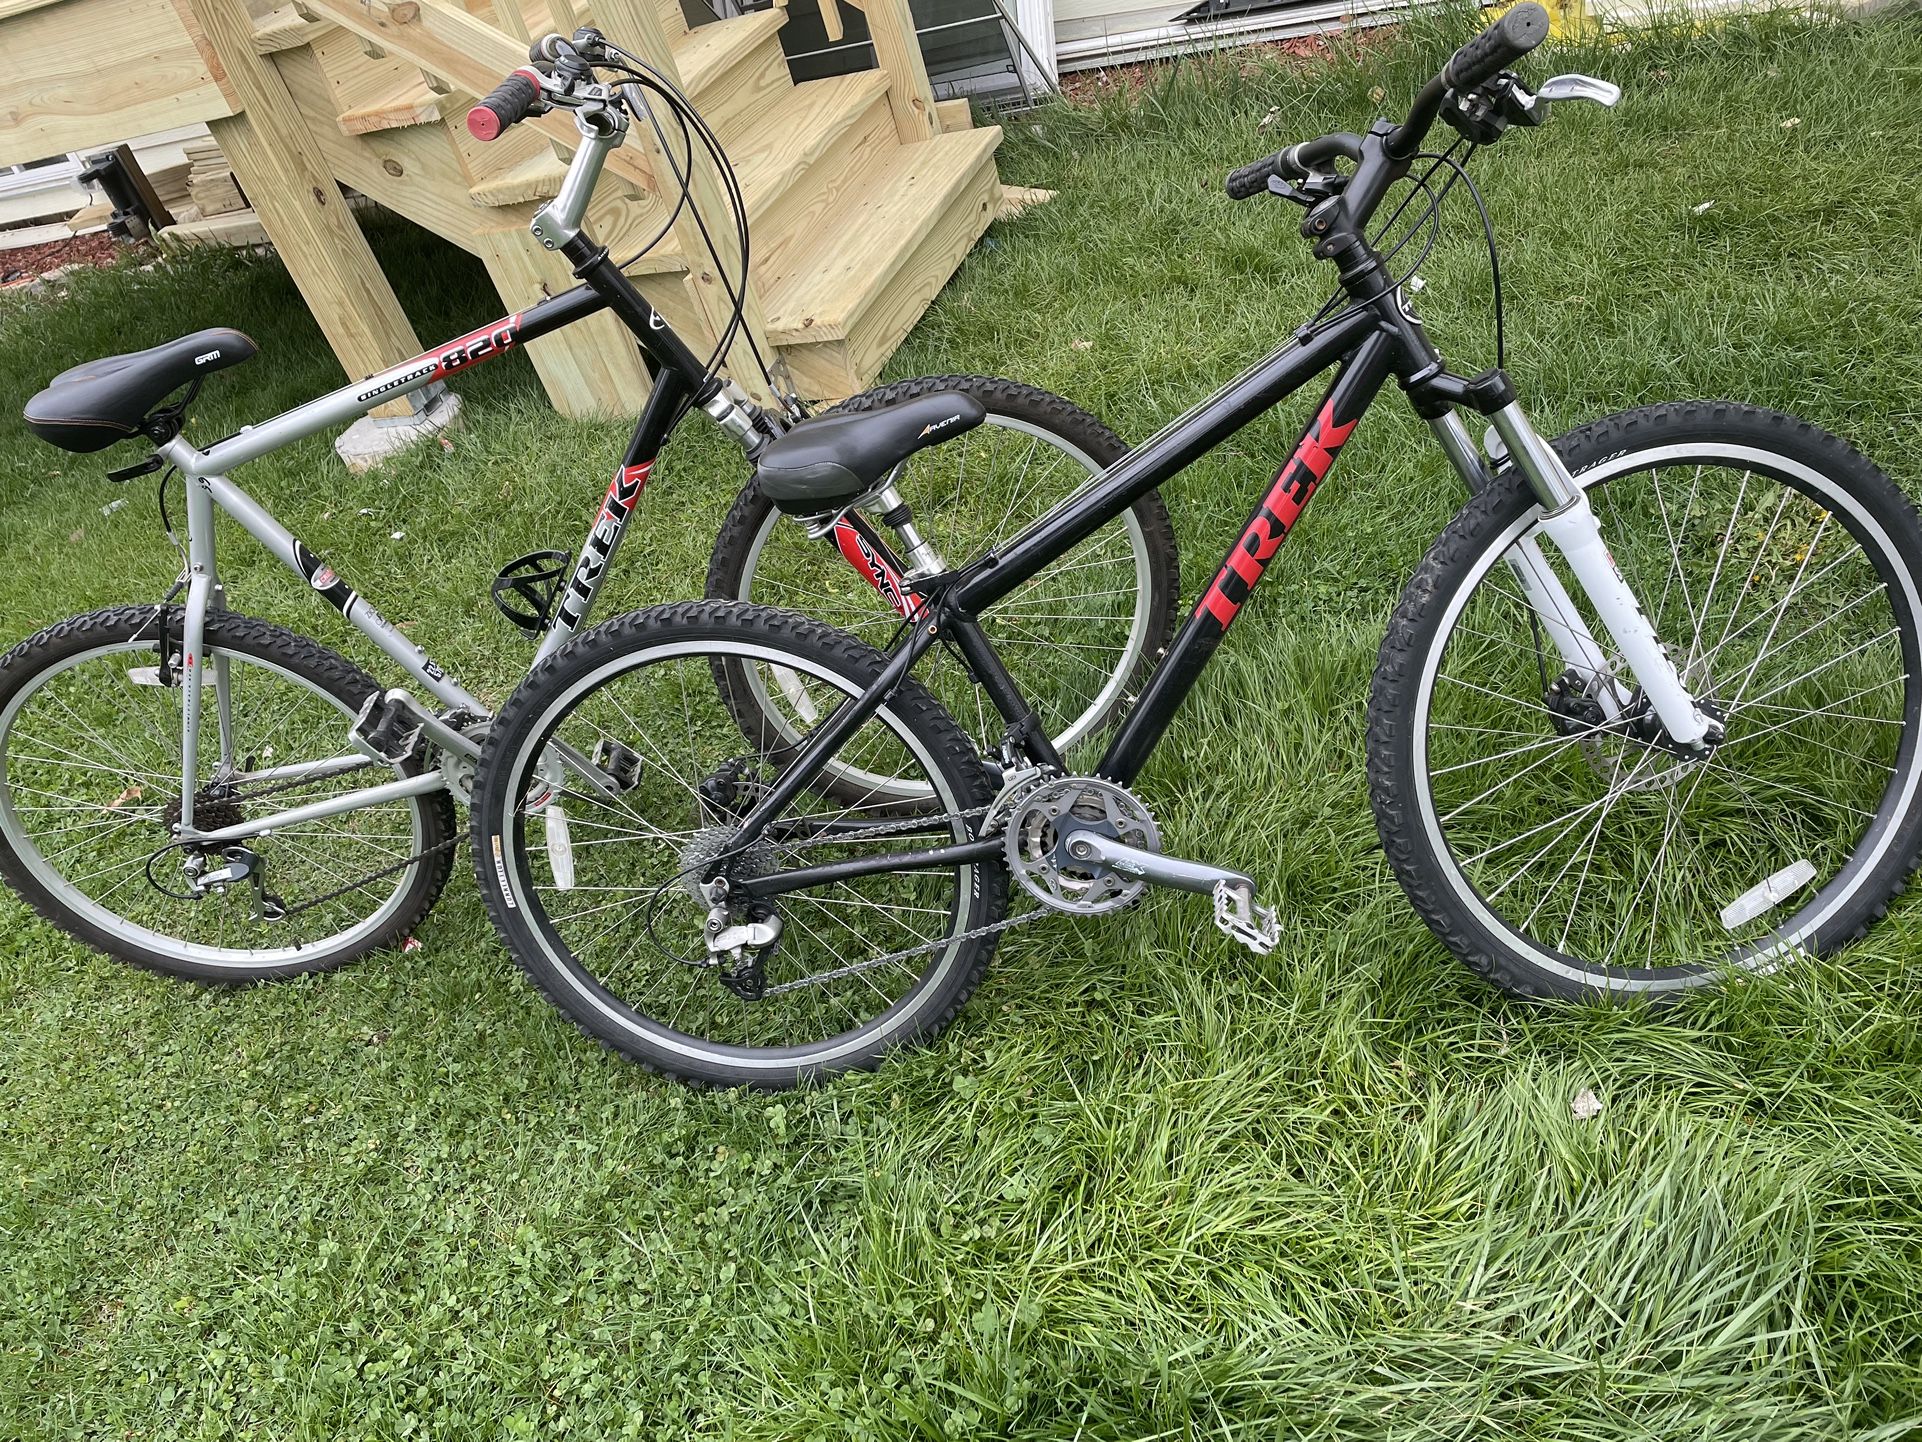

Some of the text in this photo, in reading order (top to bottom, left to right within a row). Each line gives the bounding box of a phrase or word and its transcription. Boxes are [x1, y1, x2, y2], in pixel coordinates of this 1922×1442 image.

[194, 349, 221, 366] GRM
[359, 323, 514, 401] SINGLETRACK 820
[1571, 449, 1627, 478] TRAGER
[551, 463, 642, 633] TREK
[1194, 397, 1359, 632] TREK
[855, 533, 901, 608] SYNC
